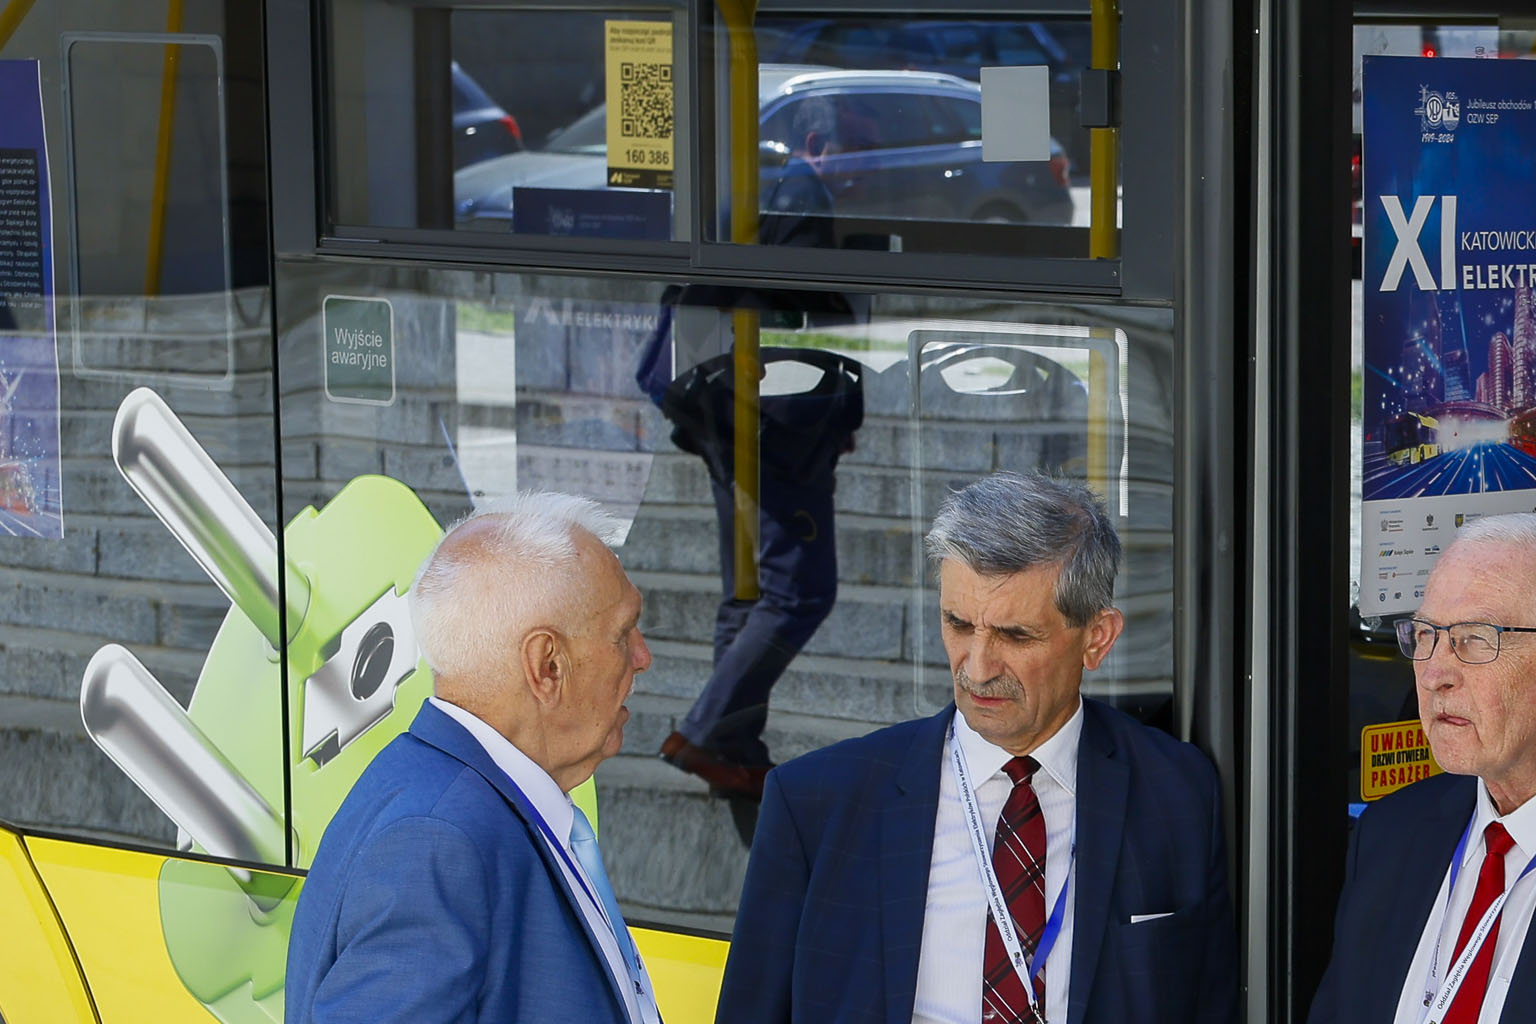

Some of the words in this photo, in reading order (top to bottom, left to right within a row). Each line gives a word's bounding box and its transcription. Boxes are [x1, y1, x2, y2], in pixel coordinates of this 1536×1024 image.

[1467, 99, 1496, 110] Jubileusz
[1497, 99, 1532, 110] obchodów
[1467, 113, 1485, 124] OZW
[1486, 113, 1499, 124] SEP
[626, 150, 645, 164] 160
[648, 150, 669, 164] 386
[1379, 195, 1457, 292] XI
[575, 313, 658, 333] ELEKTRYKI
[334, 327, 383, 350] Wyjście
[331, 350, 387, 370] awaryjne
[1372, 752, 1395, 768] DRZWI
[1396, 747, 1429, 764] OTWIERA
[1372, 763, 1430, 788] PASAŻER
